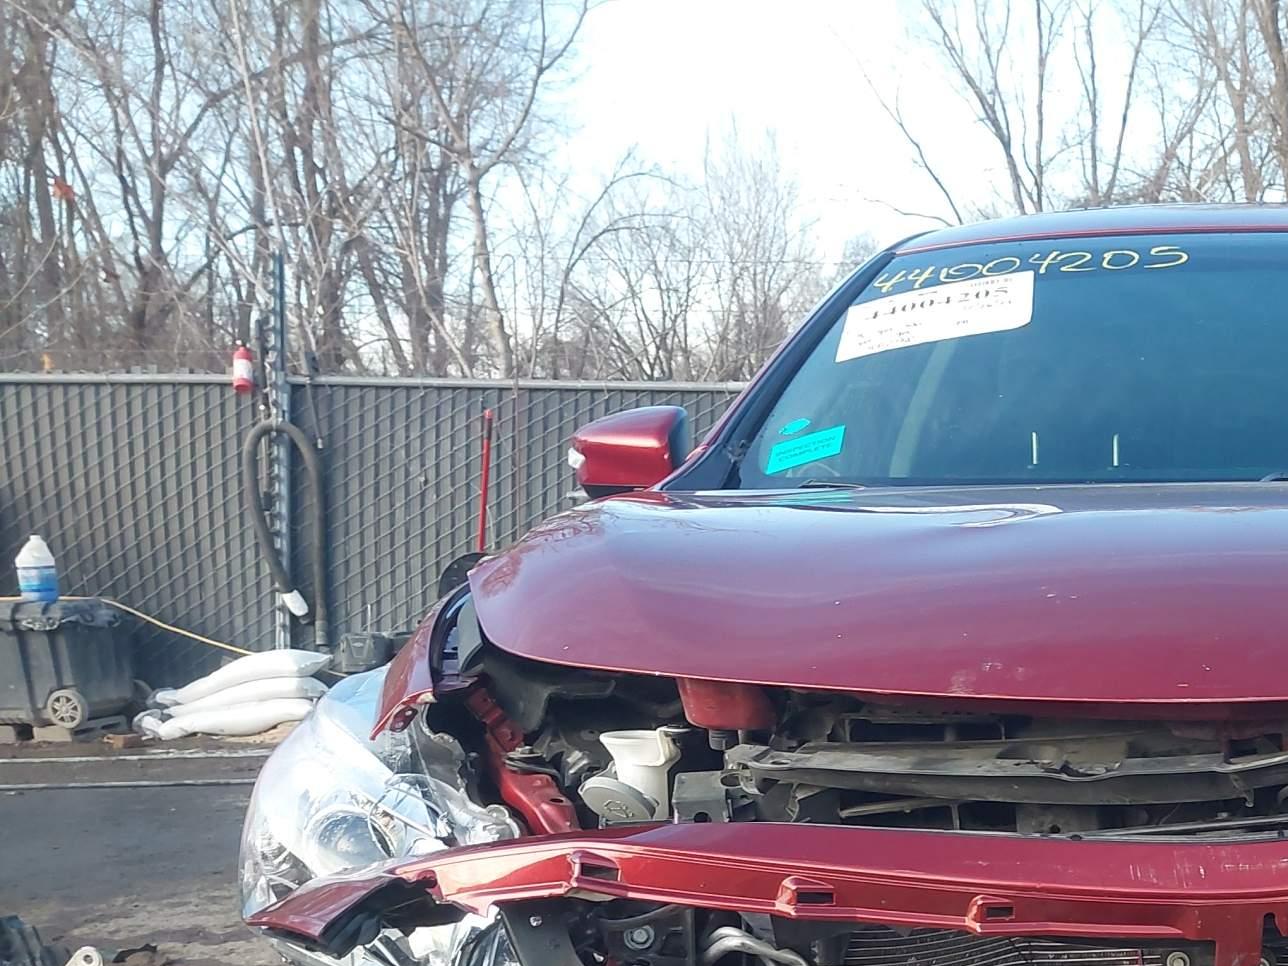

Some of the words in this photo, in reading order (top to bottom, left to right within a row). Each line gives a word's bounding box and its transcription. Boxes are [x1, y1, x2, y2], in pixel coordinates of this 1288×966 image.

[872, 246, 1190, 293] 44004205
[775, 436, 837, 457] INSPECTION
[778, 443, 832, 463] COMPLETE
